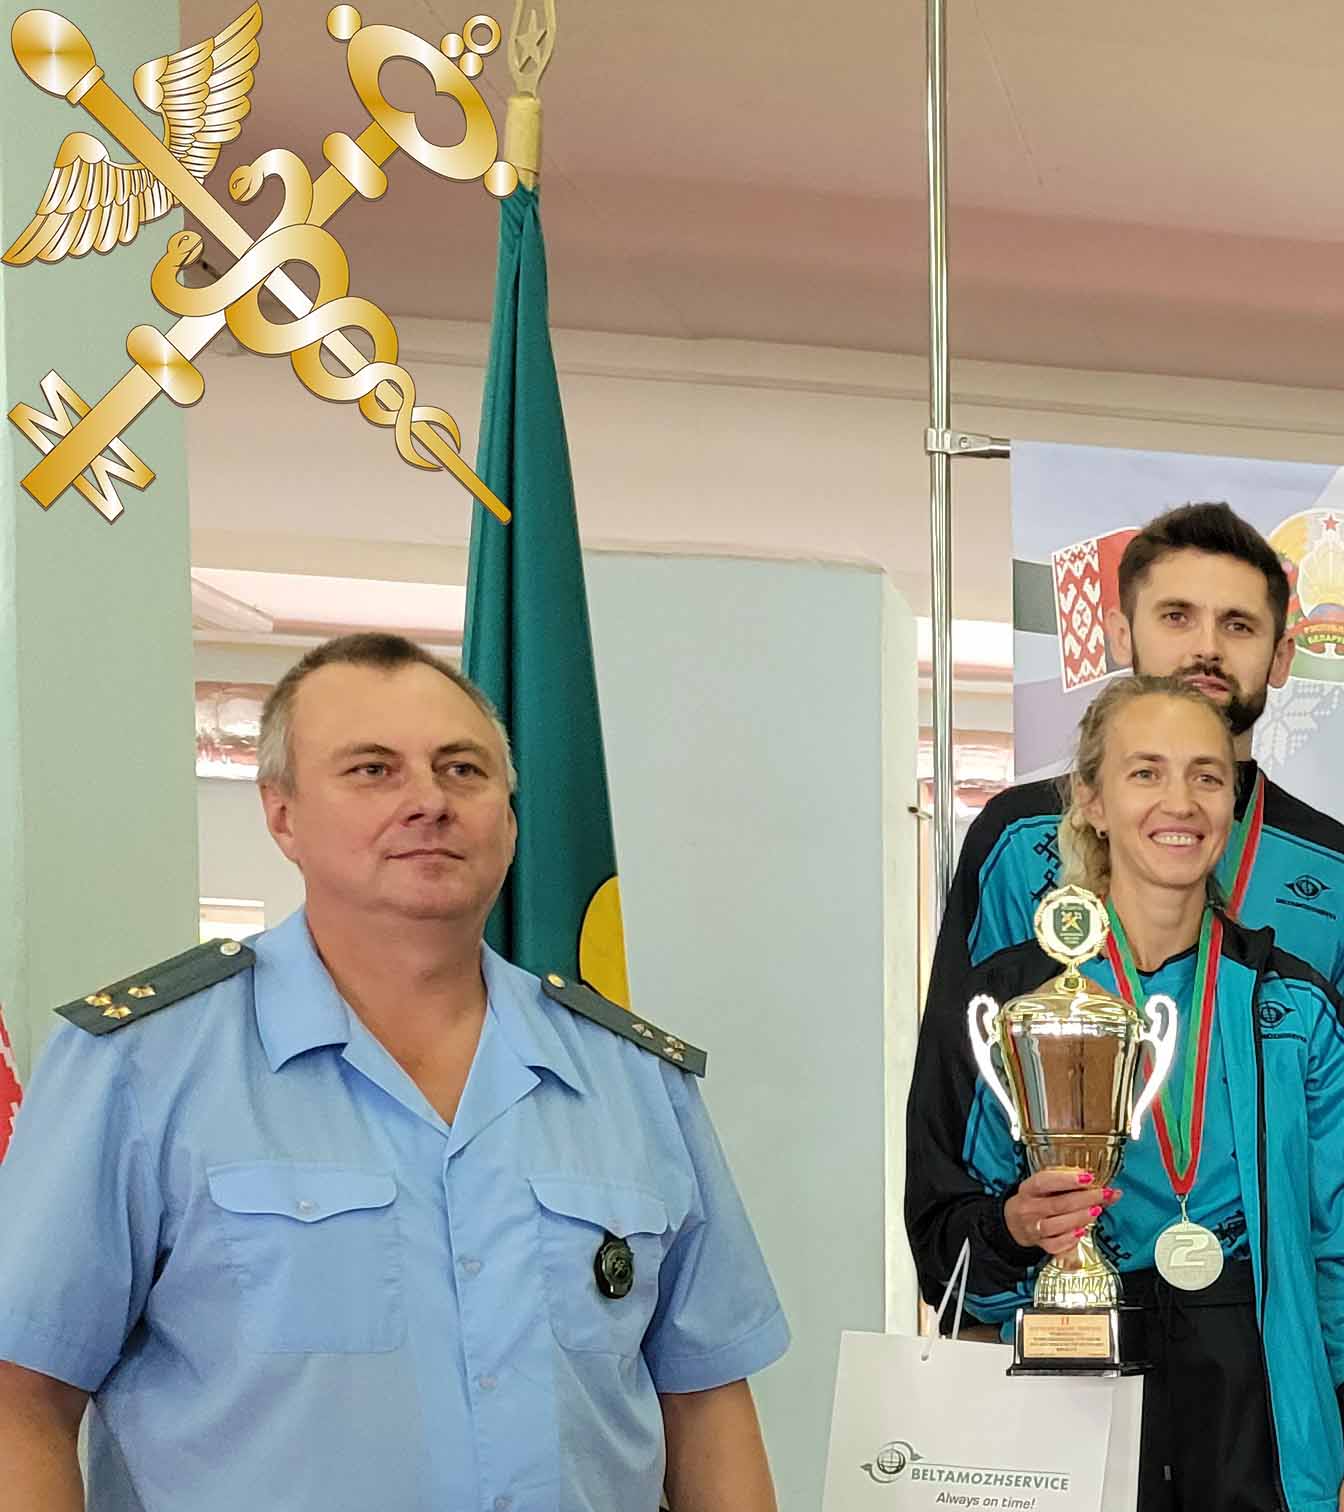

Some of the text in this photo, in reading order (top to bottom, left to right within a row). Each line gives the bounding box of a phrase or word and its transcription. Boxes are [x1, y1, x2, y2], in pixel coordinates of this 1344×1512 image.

[911, 1468, 1069, 1490] BELTAMOZHSERVICE
[936, 1492, 1036, 1510] Always on time!
